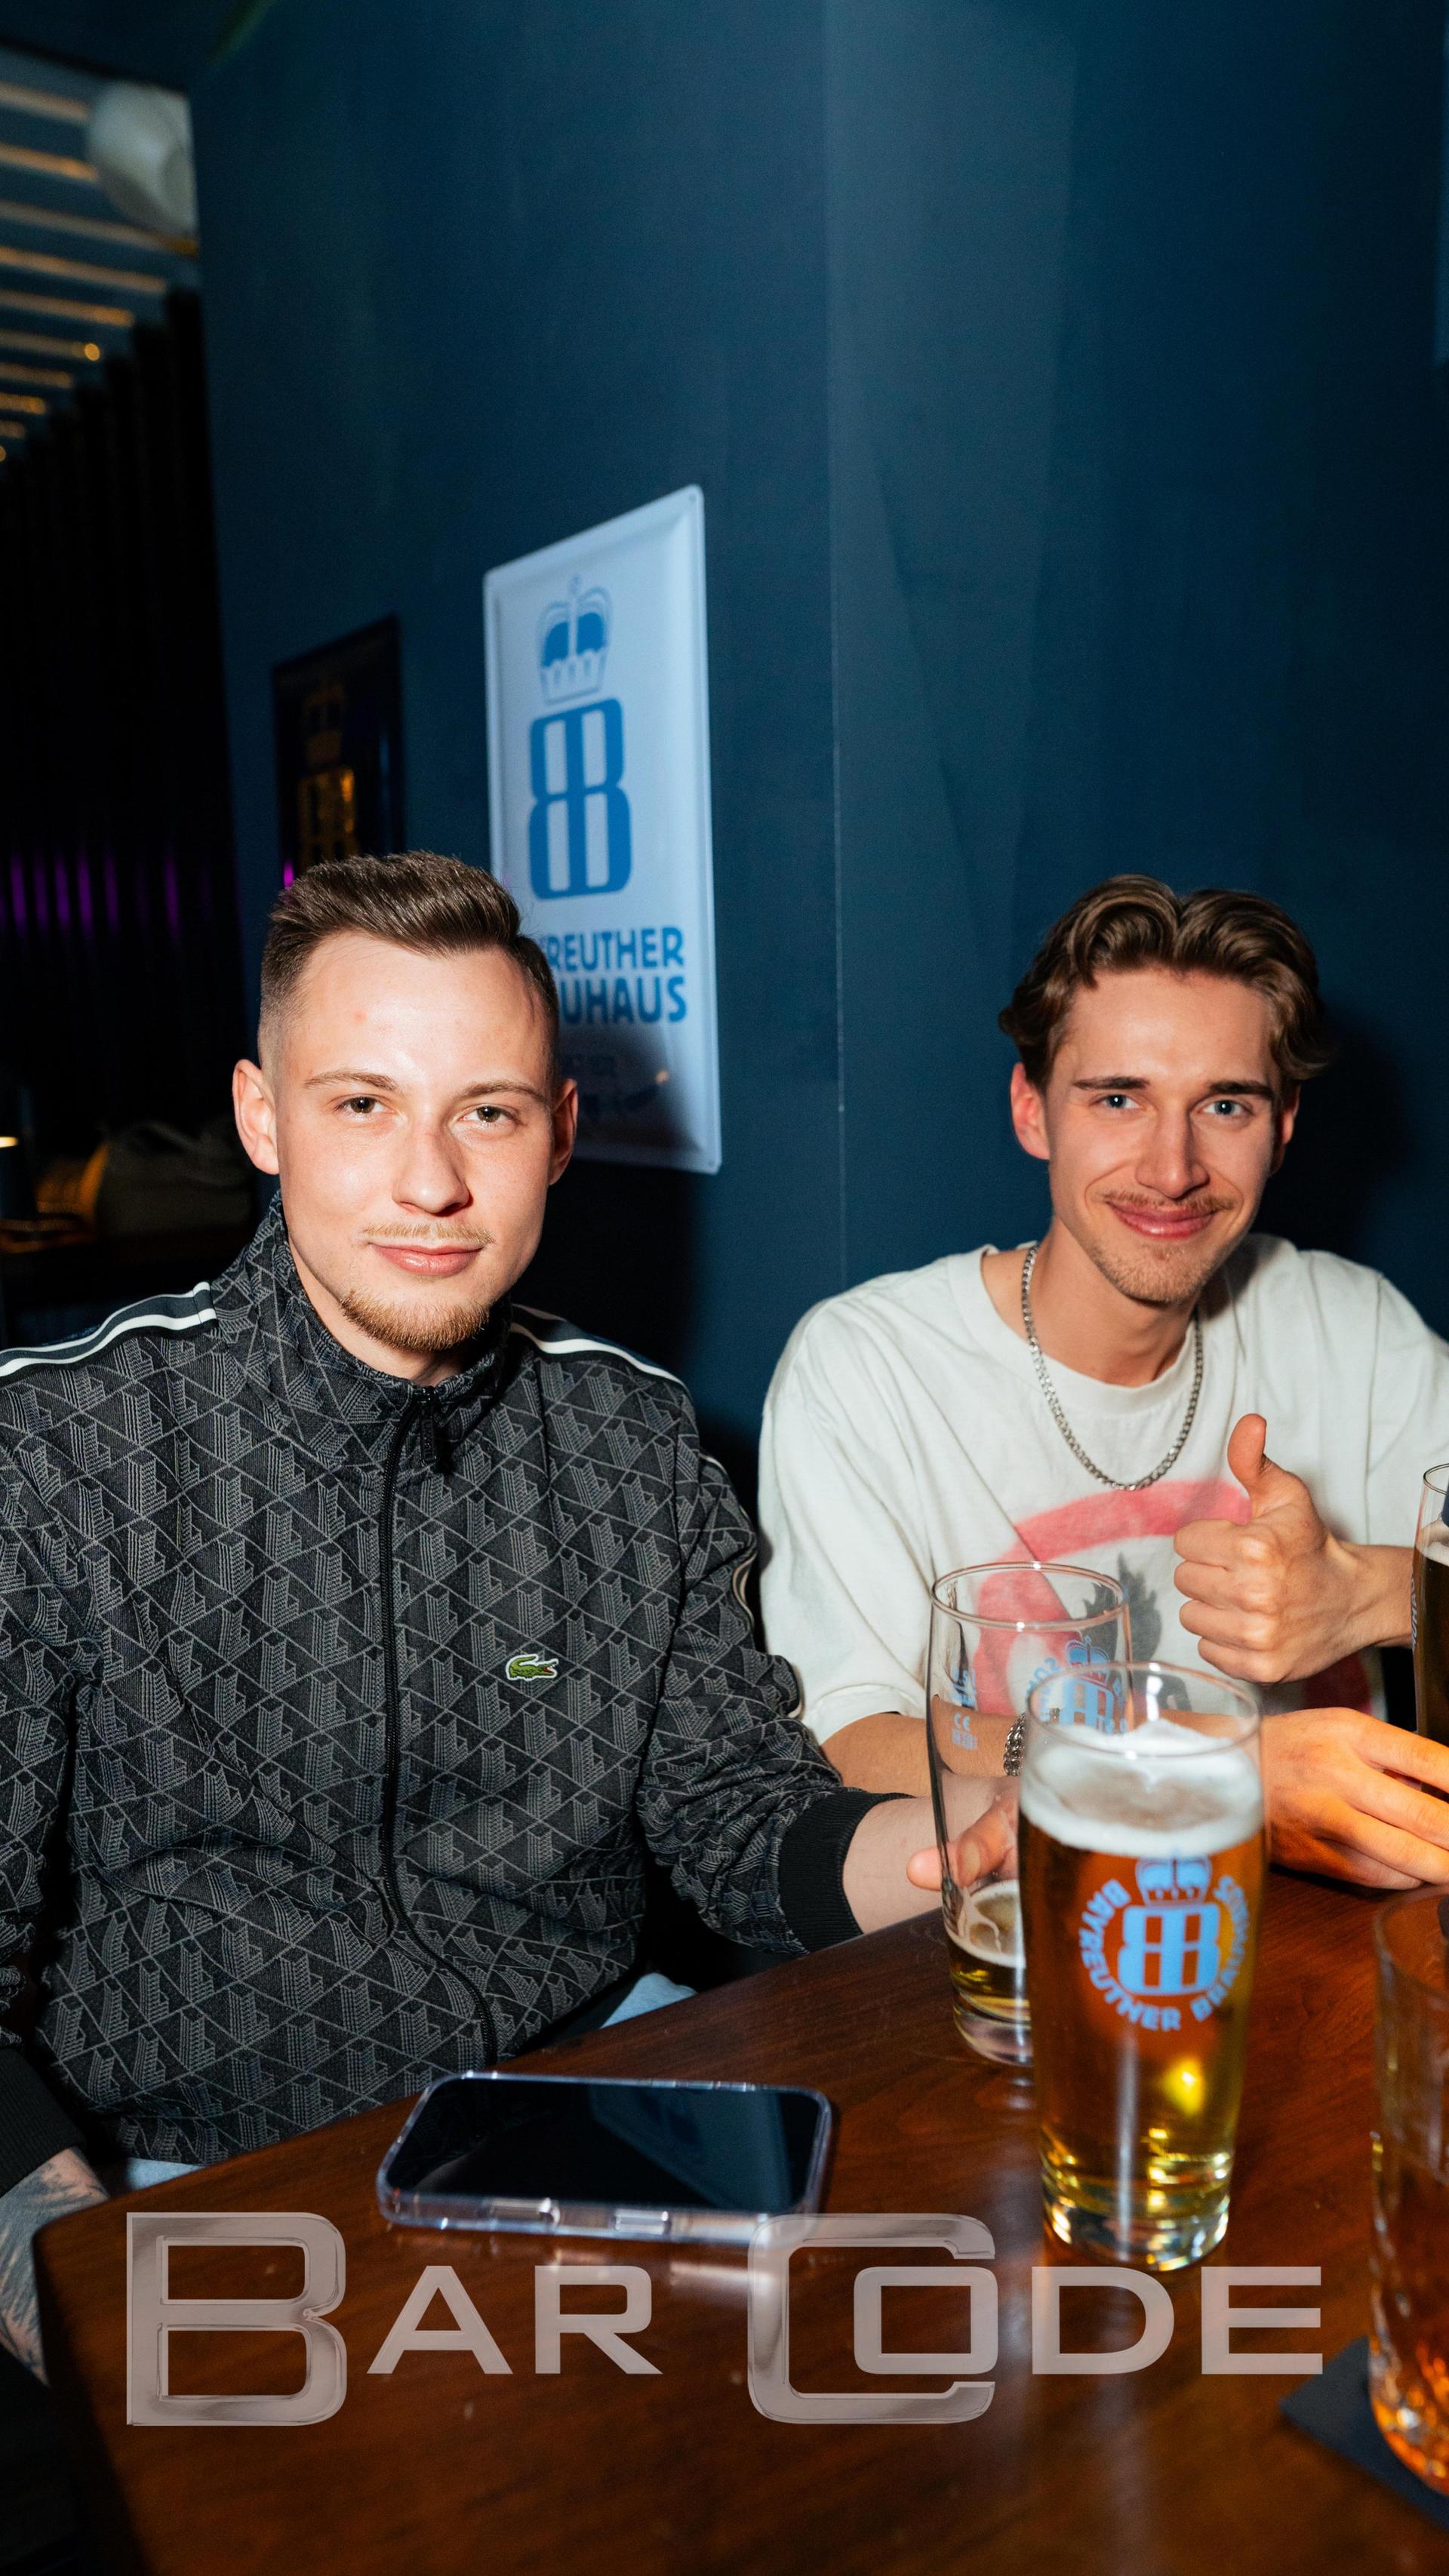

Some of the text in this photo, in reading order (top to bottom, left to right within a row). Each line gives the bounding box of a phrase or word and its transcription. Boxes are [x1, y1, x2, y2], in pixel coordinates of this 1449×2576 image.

[537, 927, 685, 973] REUTHER
[560, 976, 688, 1024] UHAUS
[1078, 1878, 1181, 2032] BAYREUTHER
